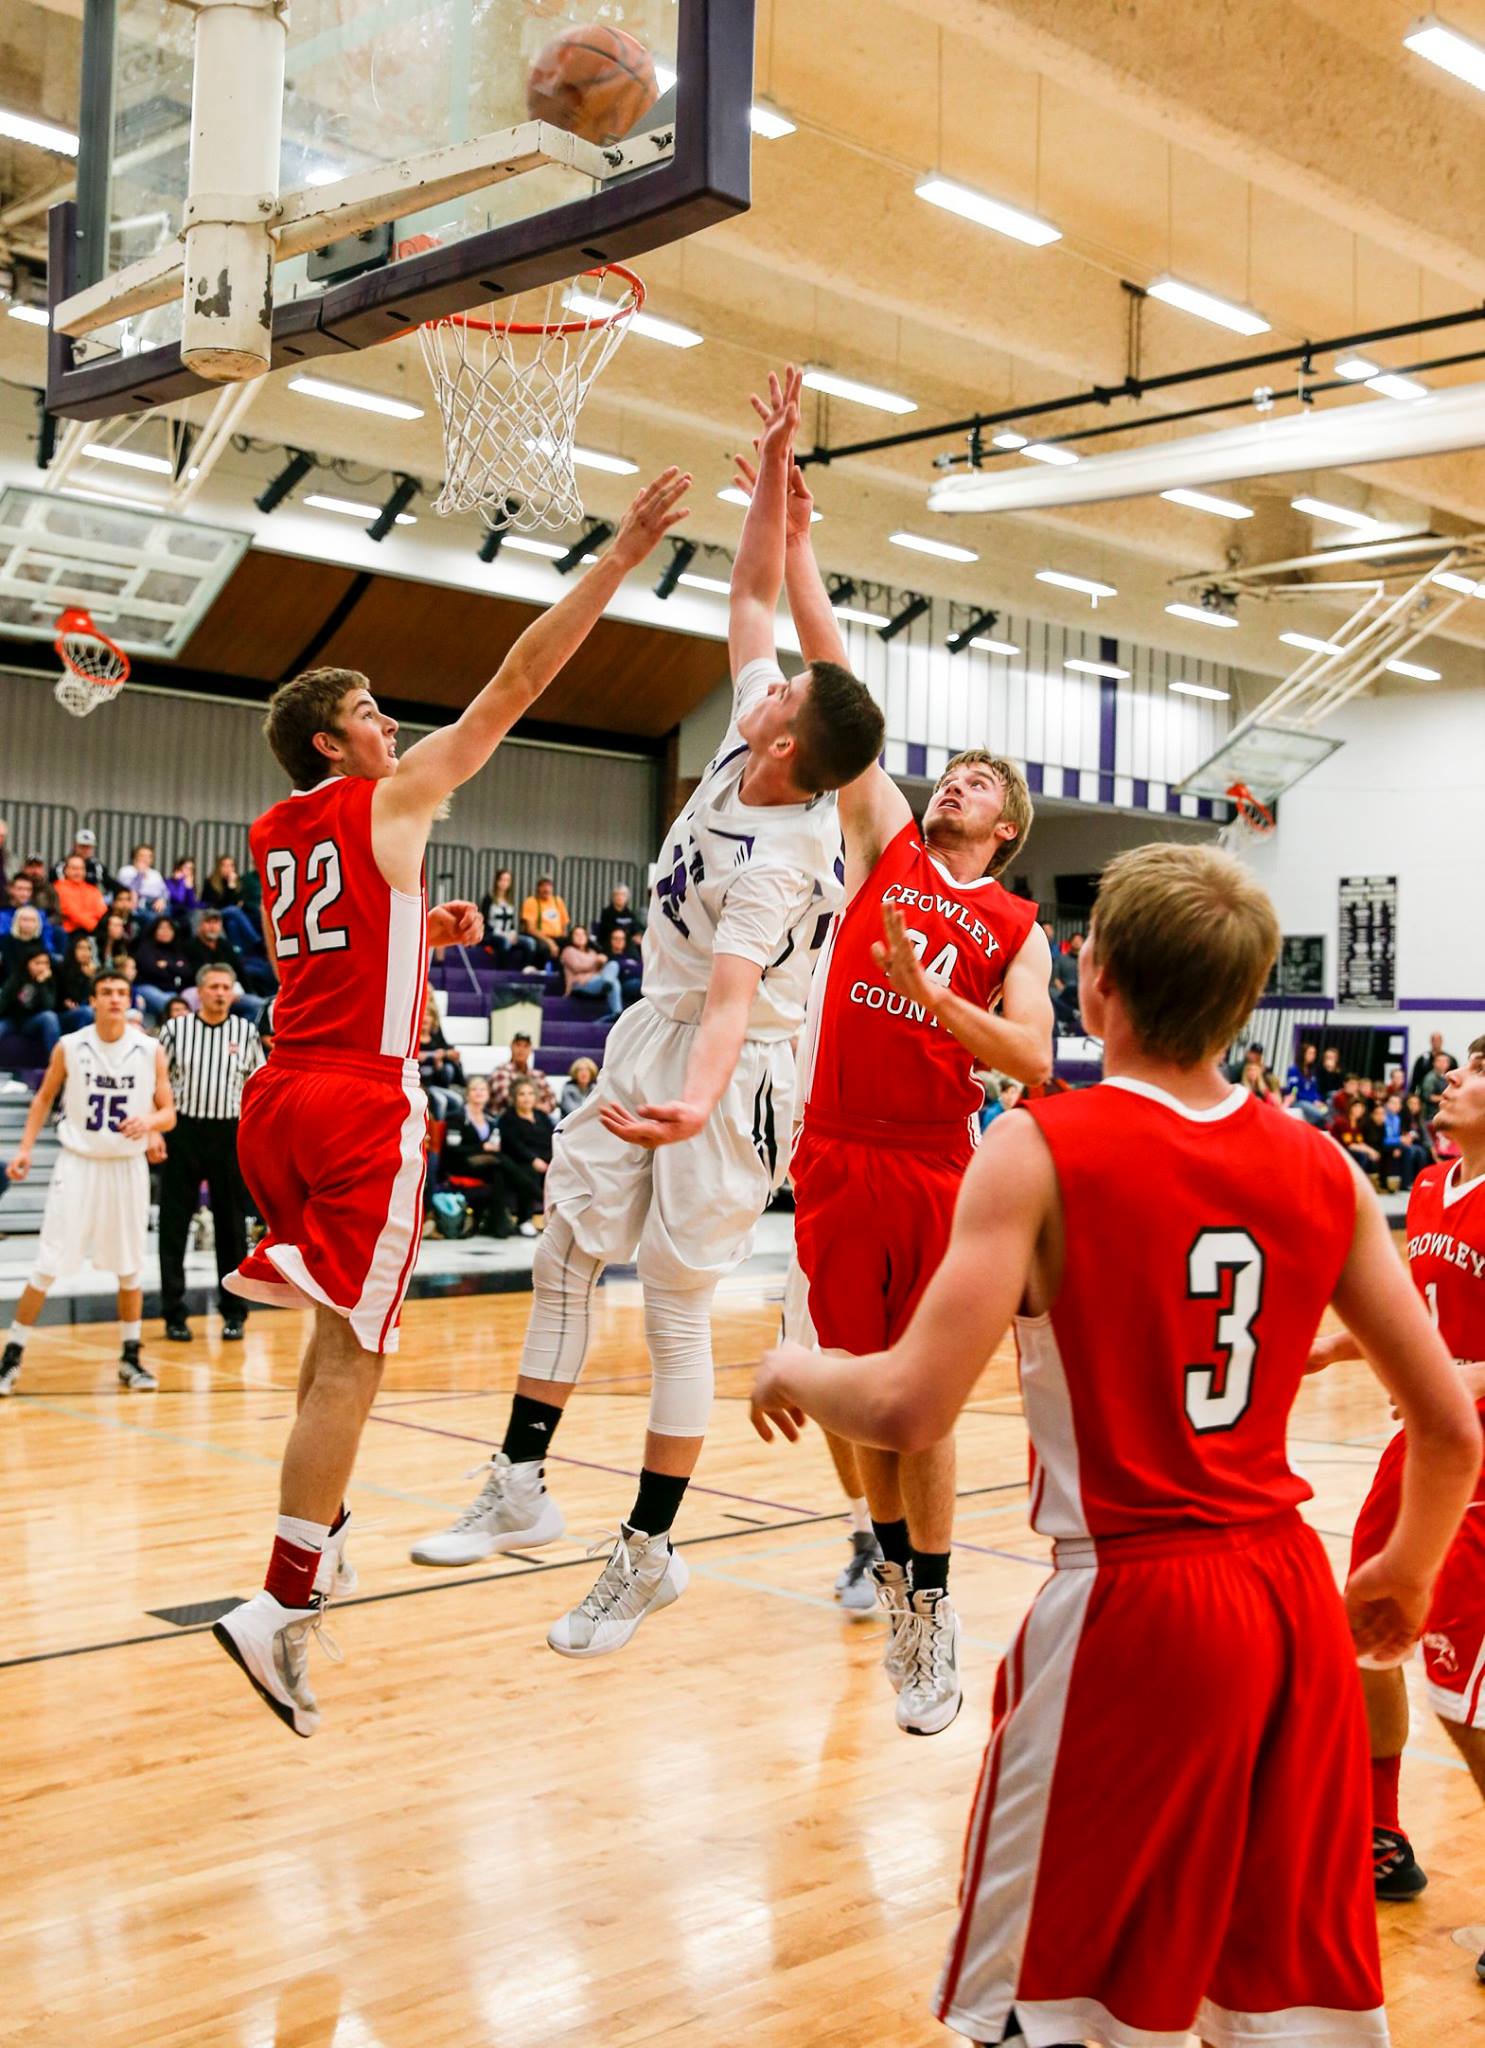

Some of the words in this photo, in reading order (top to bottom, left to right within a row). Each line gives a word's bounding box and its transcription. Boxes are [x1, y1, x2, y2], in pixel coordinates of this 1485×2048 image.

[265, 838, 349, 958] 22
[881, 883, 1000, 958] CROWLEY
[850, 980, 953, 1034] COUN
[86, 1093, 128, 1132] 35
[1407, 1232, 1485, 1279] ROWLEY
[1185, 1226, 1265, 1436] 3
